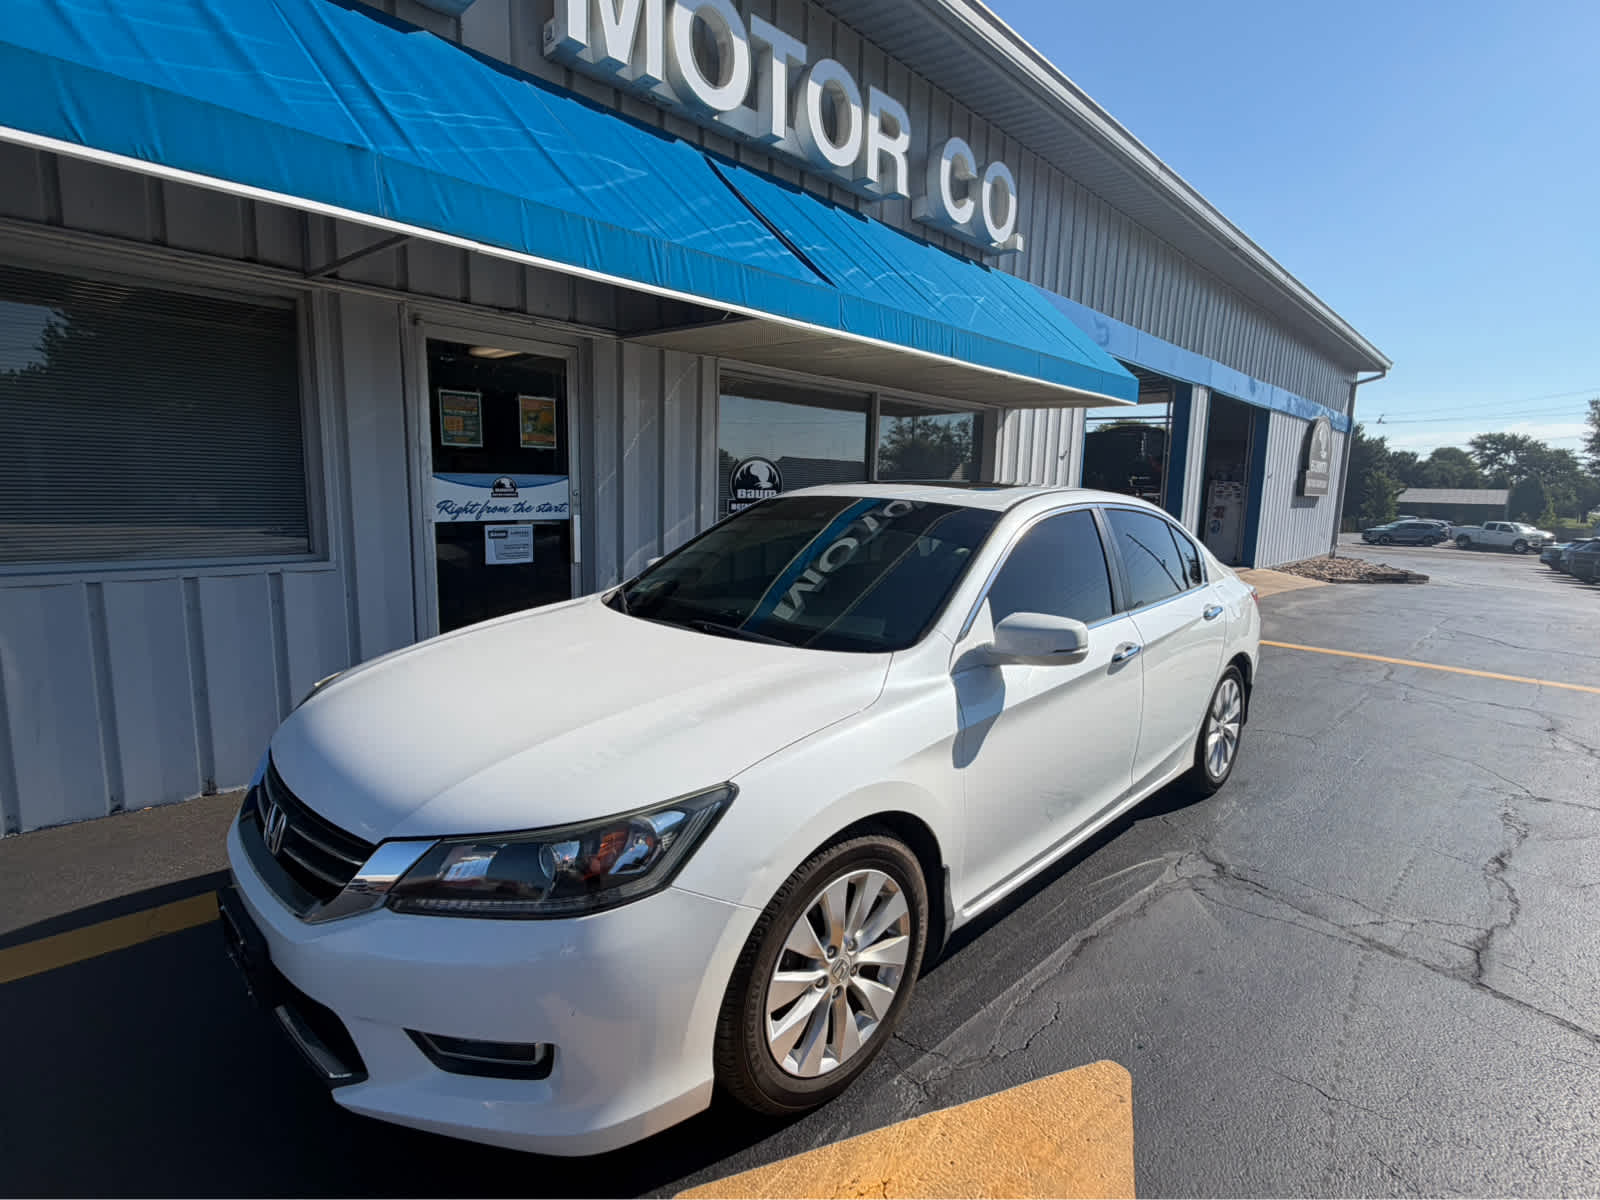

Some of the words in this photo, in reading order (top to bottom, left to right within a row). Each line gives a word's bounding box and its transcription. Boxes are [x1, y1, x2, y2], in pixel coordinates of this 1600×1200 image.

[939, 136, 1024, 252] CO.
[436, 499, 481, 520] Right
[475, 499, 511, 520] from
[512, 500, 533, 513] the
